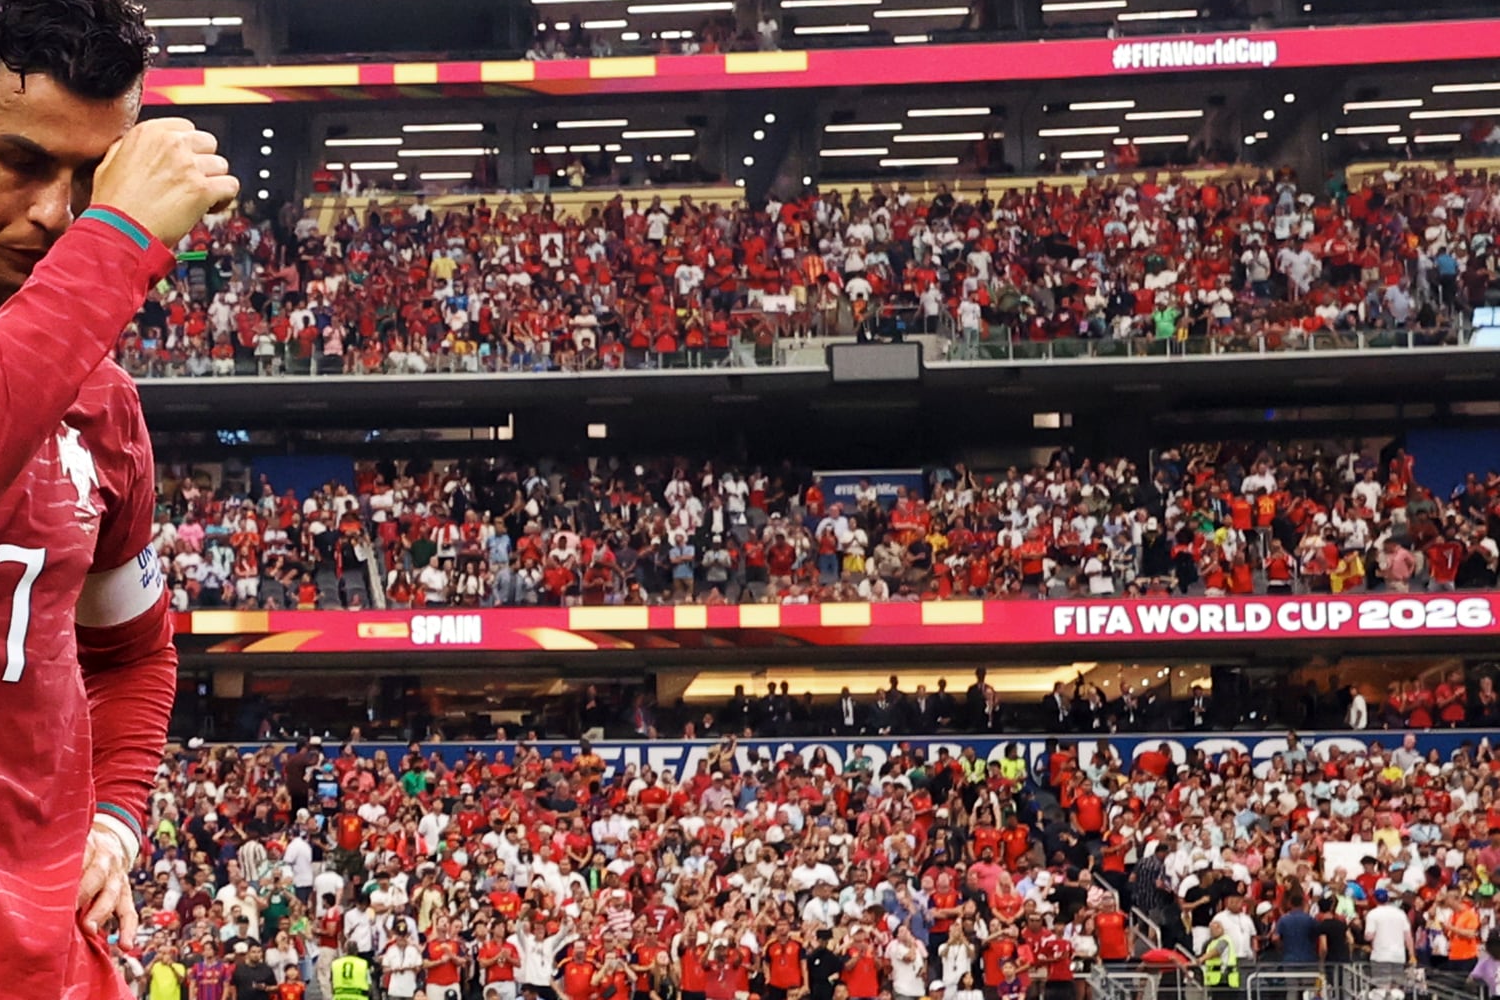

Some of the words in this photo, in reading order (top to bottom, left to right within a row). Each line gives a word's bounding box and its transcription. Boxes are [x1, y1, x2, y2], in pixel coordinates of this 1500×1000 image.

[1112, 37, 1277, 69] #FIFAWorldCup
[411, 615, 482, 645] SPAIN
[1054, 606, 1132, 635] FIFA
[1137, 603, 1272, 634] WORLD
[1277, 602, 1353, 632] CUP
[1358, 598, 1492, 630] 2026
